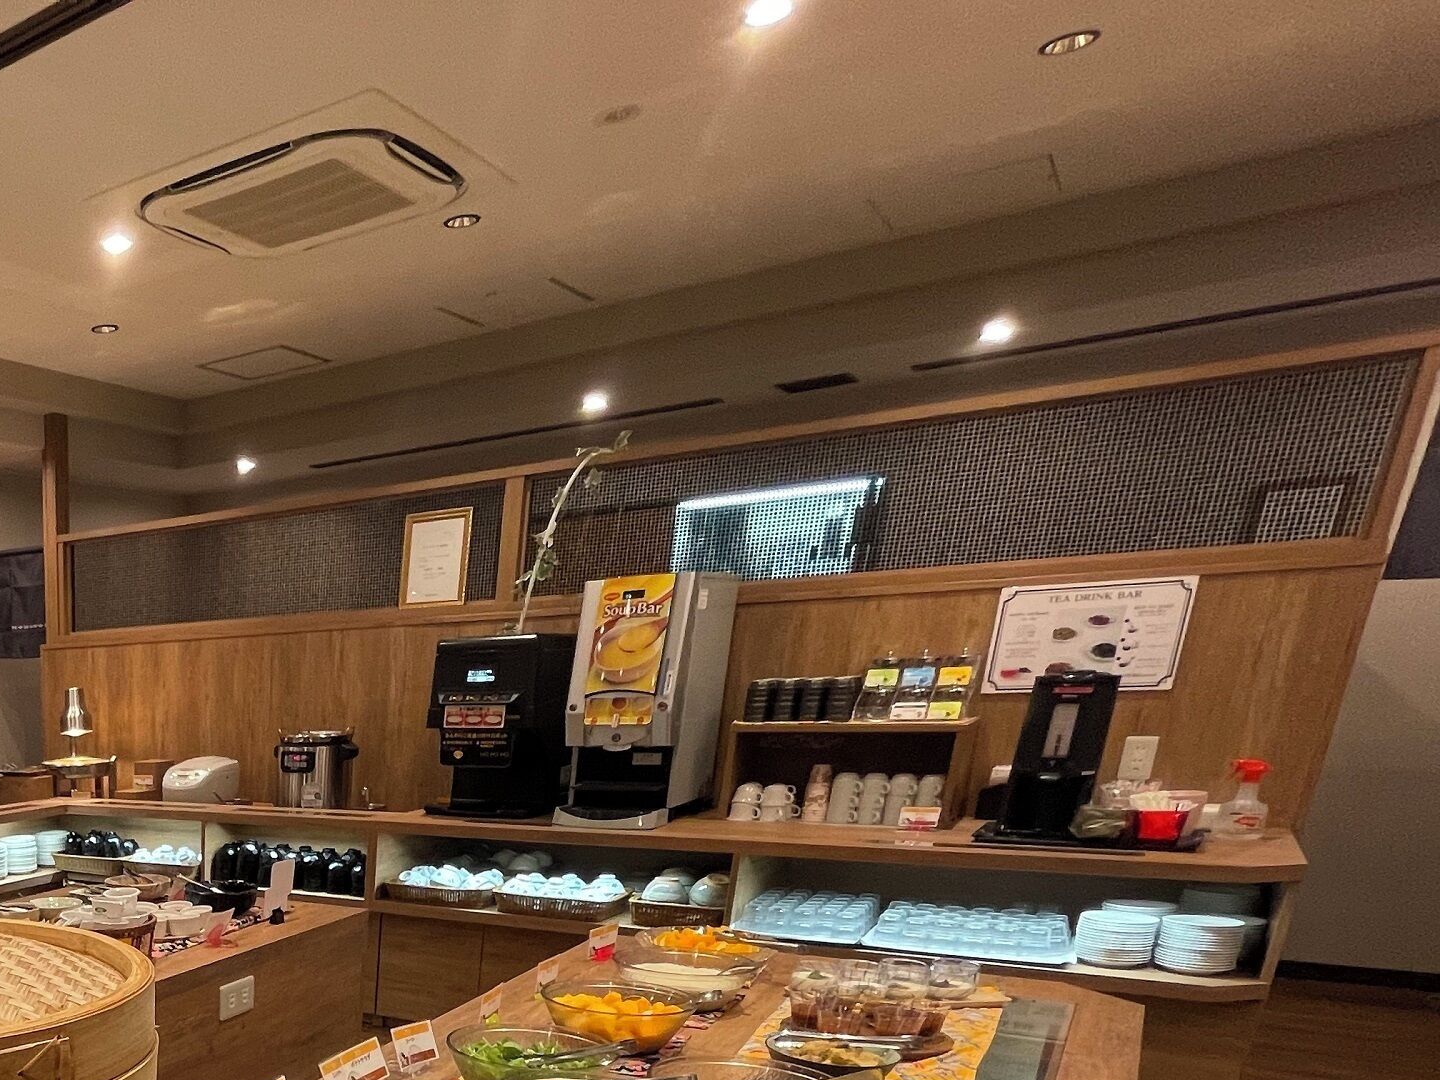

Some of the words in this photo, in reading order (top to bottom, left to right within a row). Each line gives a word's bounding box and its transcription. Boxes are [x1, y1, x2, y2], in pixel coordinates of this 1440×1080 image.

[1049, 594, 1070, 603] TEA
[1075, 592, 1113, 601] DRINK
[1117, 590, 1143, 599] BAR
[637, 602, 663, 615] Bar
